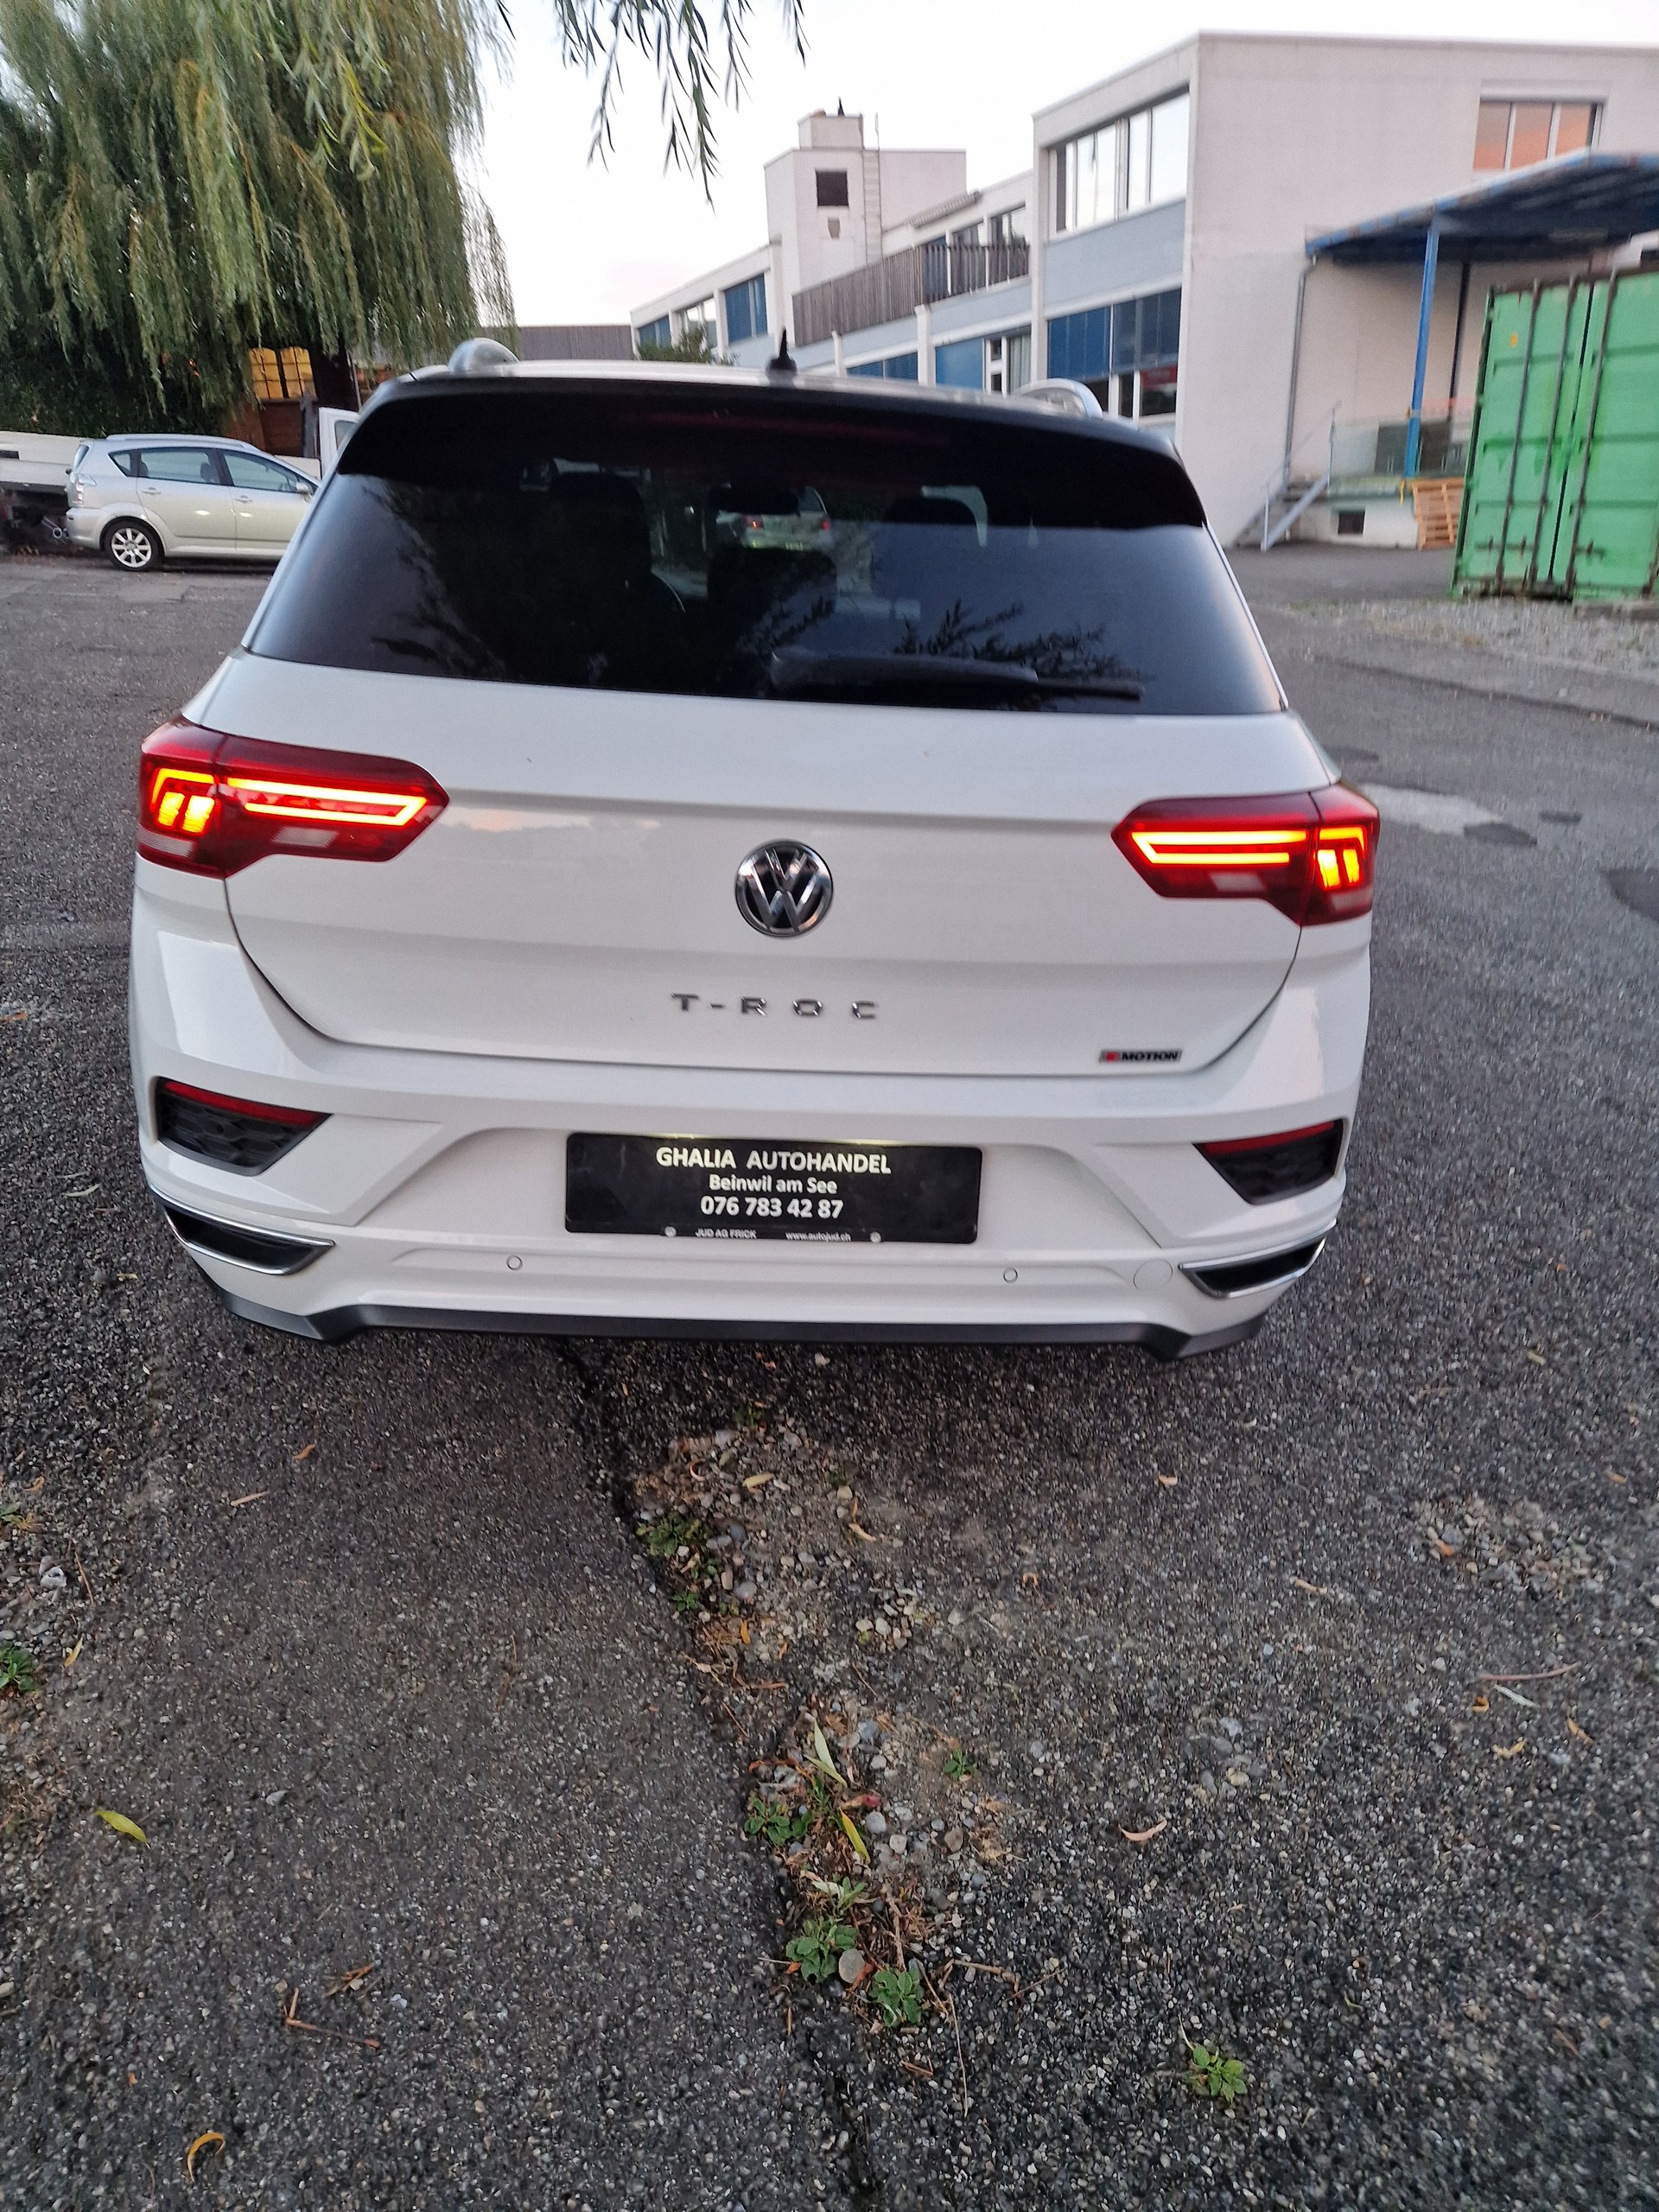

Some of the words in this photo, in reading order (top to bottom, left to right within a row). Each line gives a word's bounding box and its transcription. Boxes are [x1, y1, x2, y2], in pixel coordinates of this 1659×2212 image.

[671, 992, 877, 1019] T-ROC
[656, 1147, 737, 1169] GHALIA
[746, 1150, 892, 1174] AUTOHANDEL
[709, 1173, 772, 1192] Beinwil
[776, 1179, 803, 1192] am
[806, 1176, 837, 1194] See
[701, 1195, 739, 1216] 076
[744, 1196, 782, 1217] 783
[787, 1198, 812, 1218] 42
[817, 1198, 844, 1219] 87
[696, 1228, 714, 1237] JUD
[730, 1229, 757, 1239] FRICK
